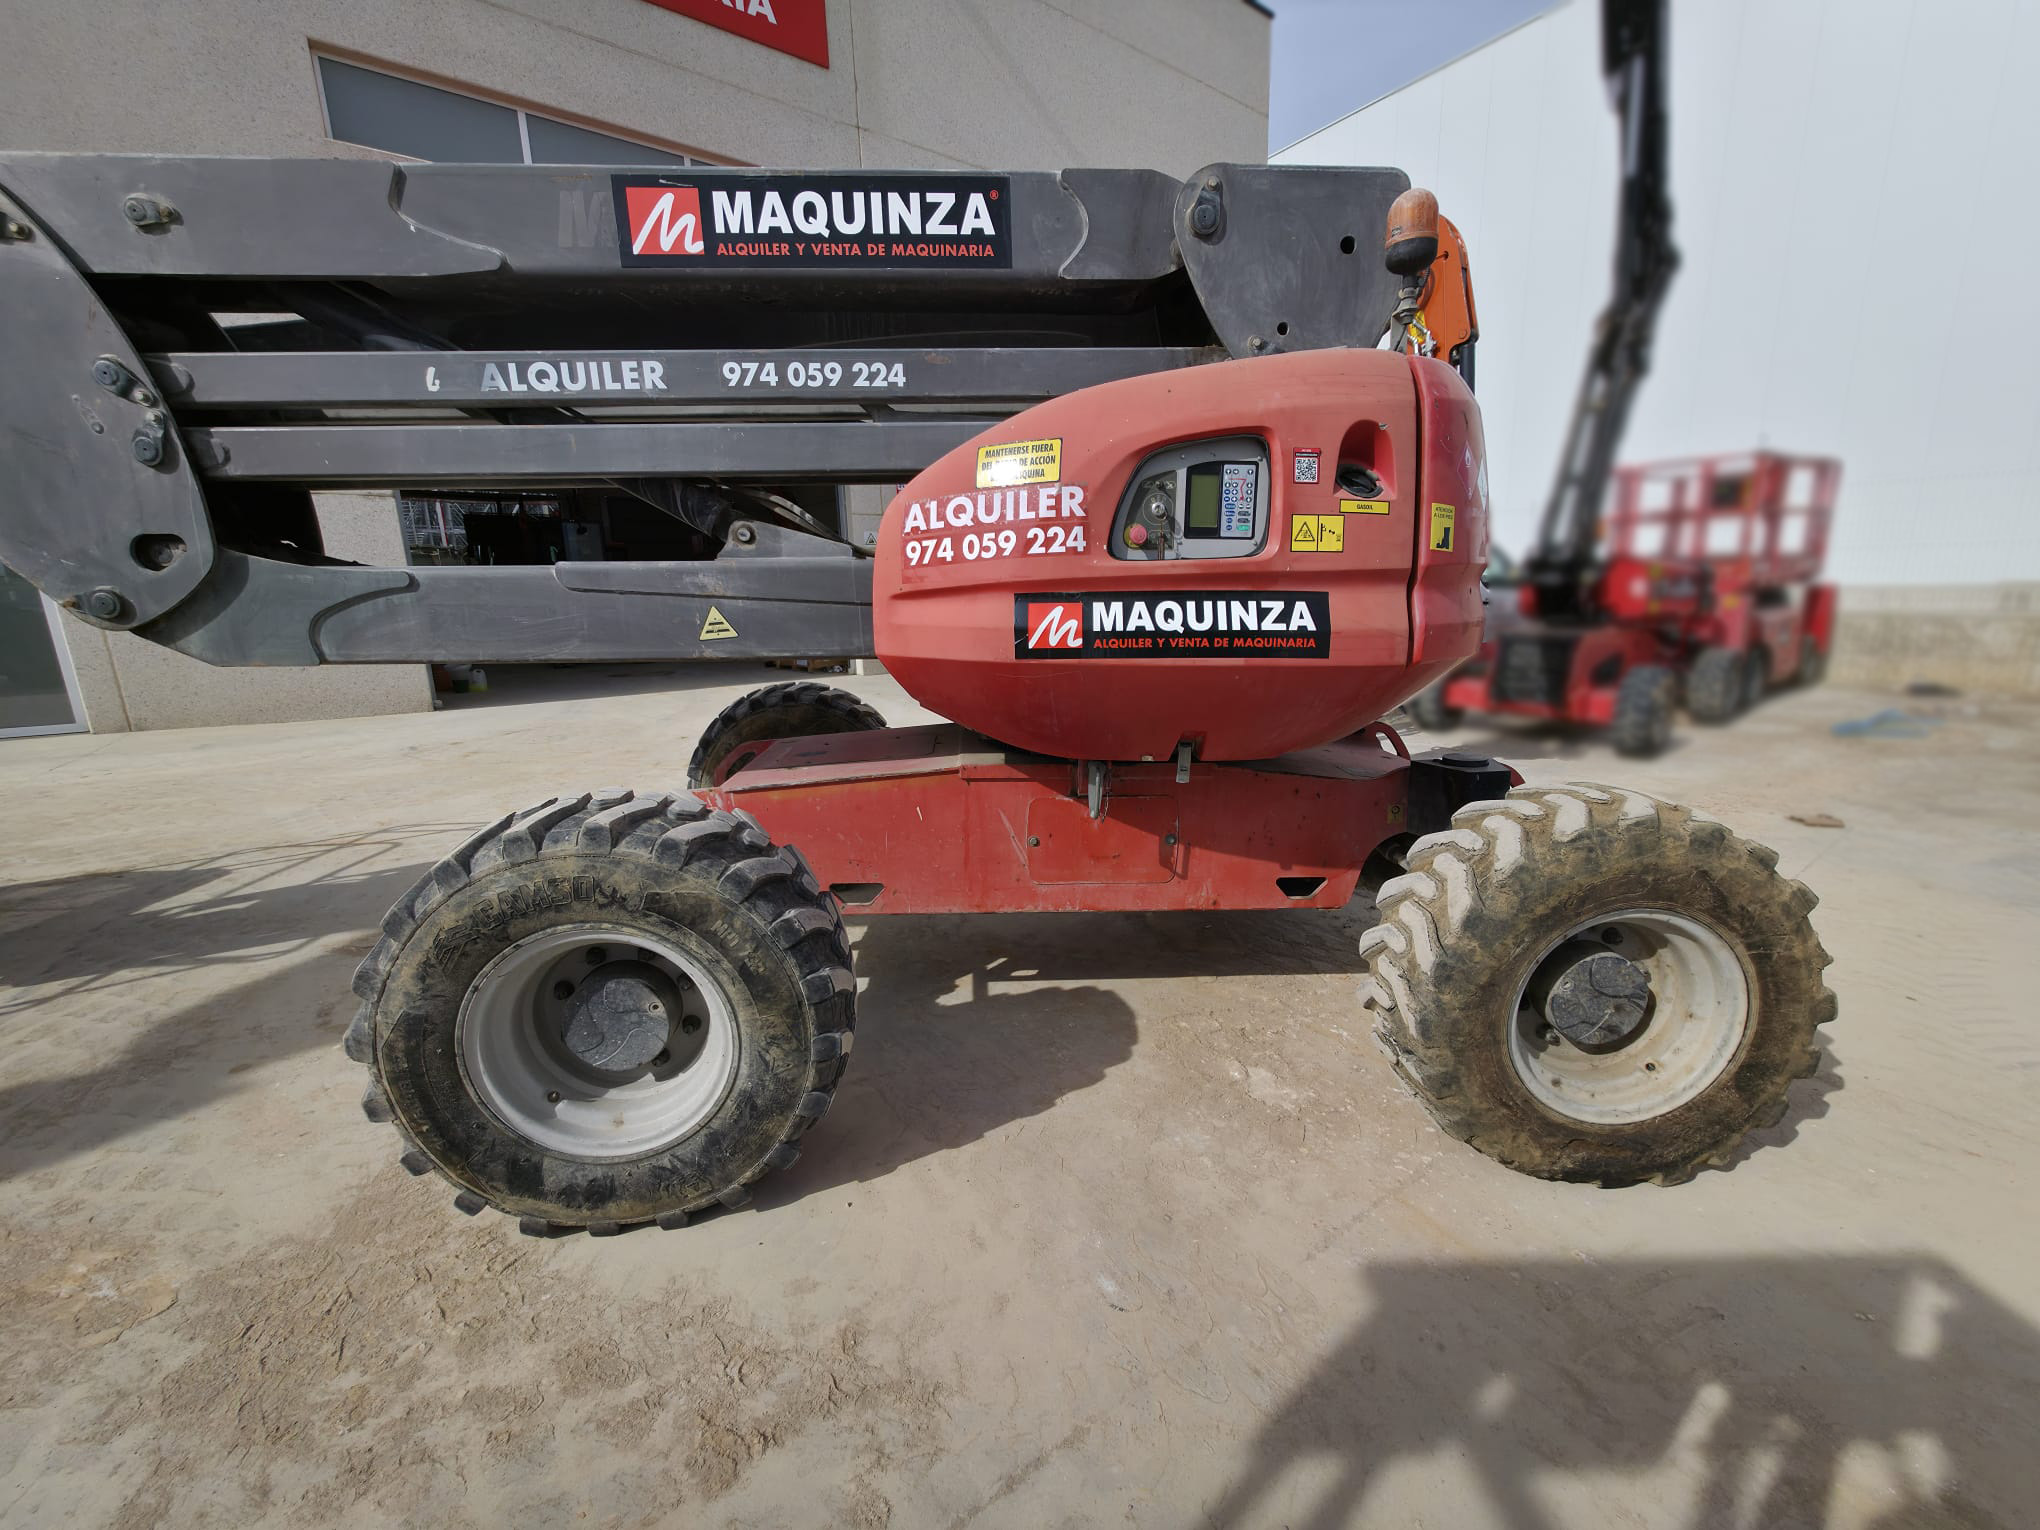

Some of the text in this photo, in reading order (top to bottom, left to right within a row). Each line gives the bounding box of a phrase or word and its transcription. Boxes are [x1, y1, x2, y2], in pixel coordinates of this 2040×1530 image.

[712, 190, 996, 238] MAQUINZA
[717, 242, 995, 257] ALQUILER Y VENTA DE MAQUINARIA
[480, 360, 668, 393] ALQUILER
[722, 361, 907, 388] 974 059 224
[984, 443, 1054, 459] MANTENERSE FUERA
[1019, 457, 1028, 467] DE
[1029, 453, 1056, 466] ACCIÓN
[903, 486, 1087, 534] ALQUILER
[905, 525, 1087, 566] 974 059 224
[1092, 600, 1317, 634] MAQUINZA
[1093, 636, 1317, 649] ALQUILER Y VENTA DE MAQUINARIA
